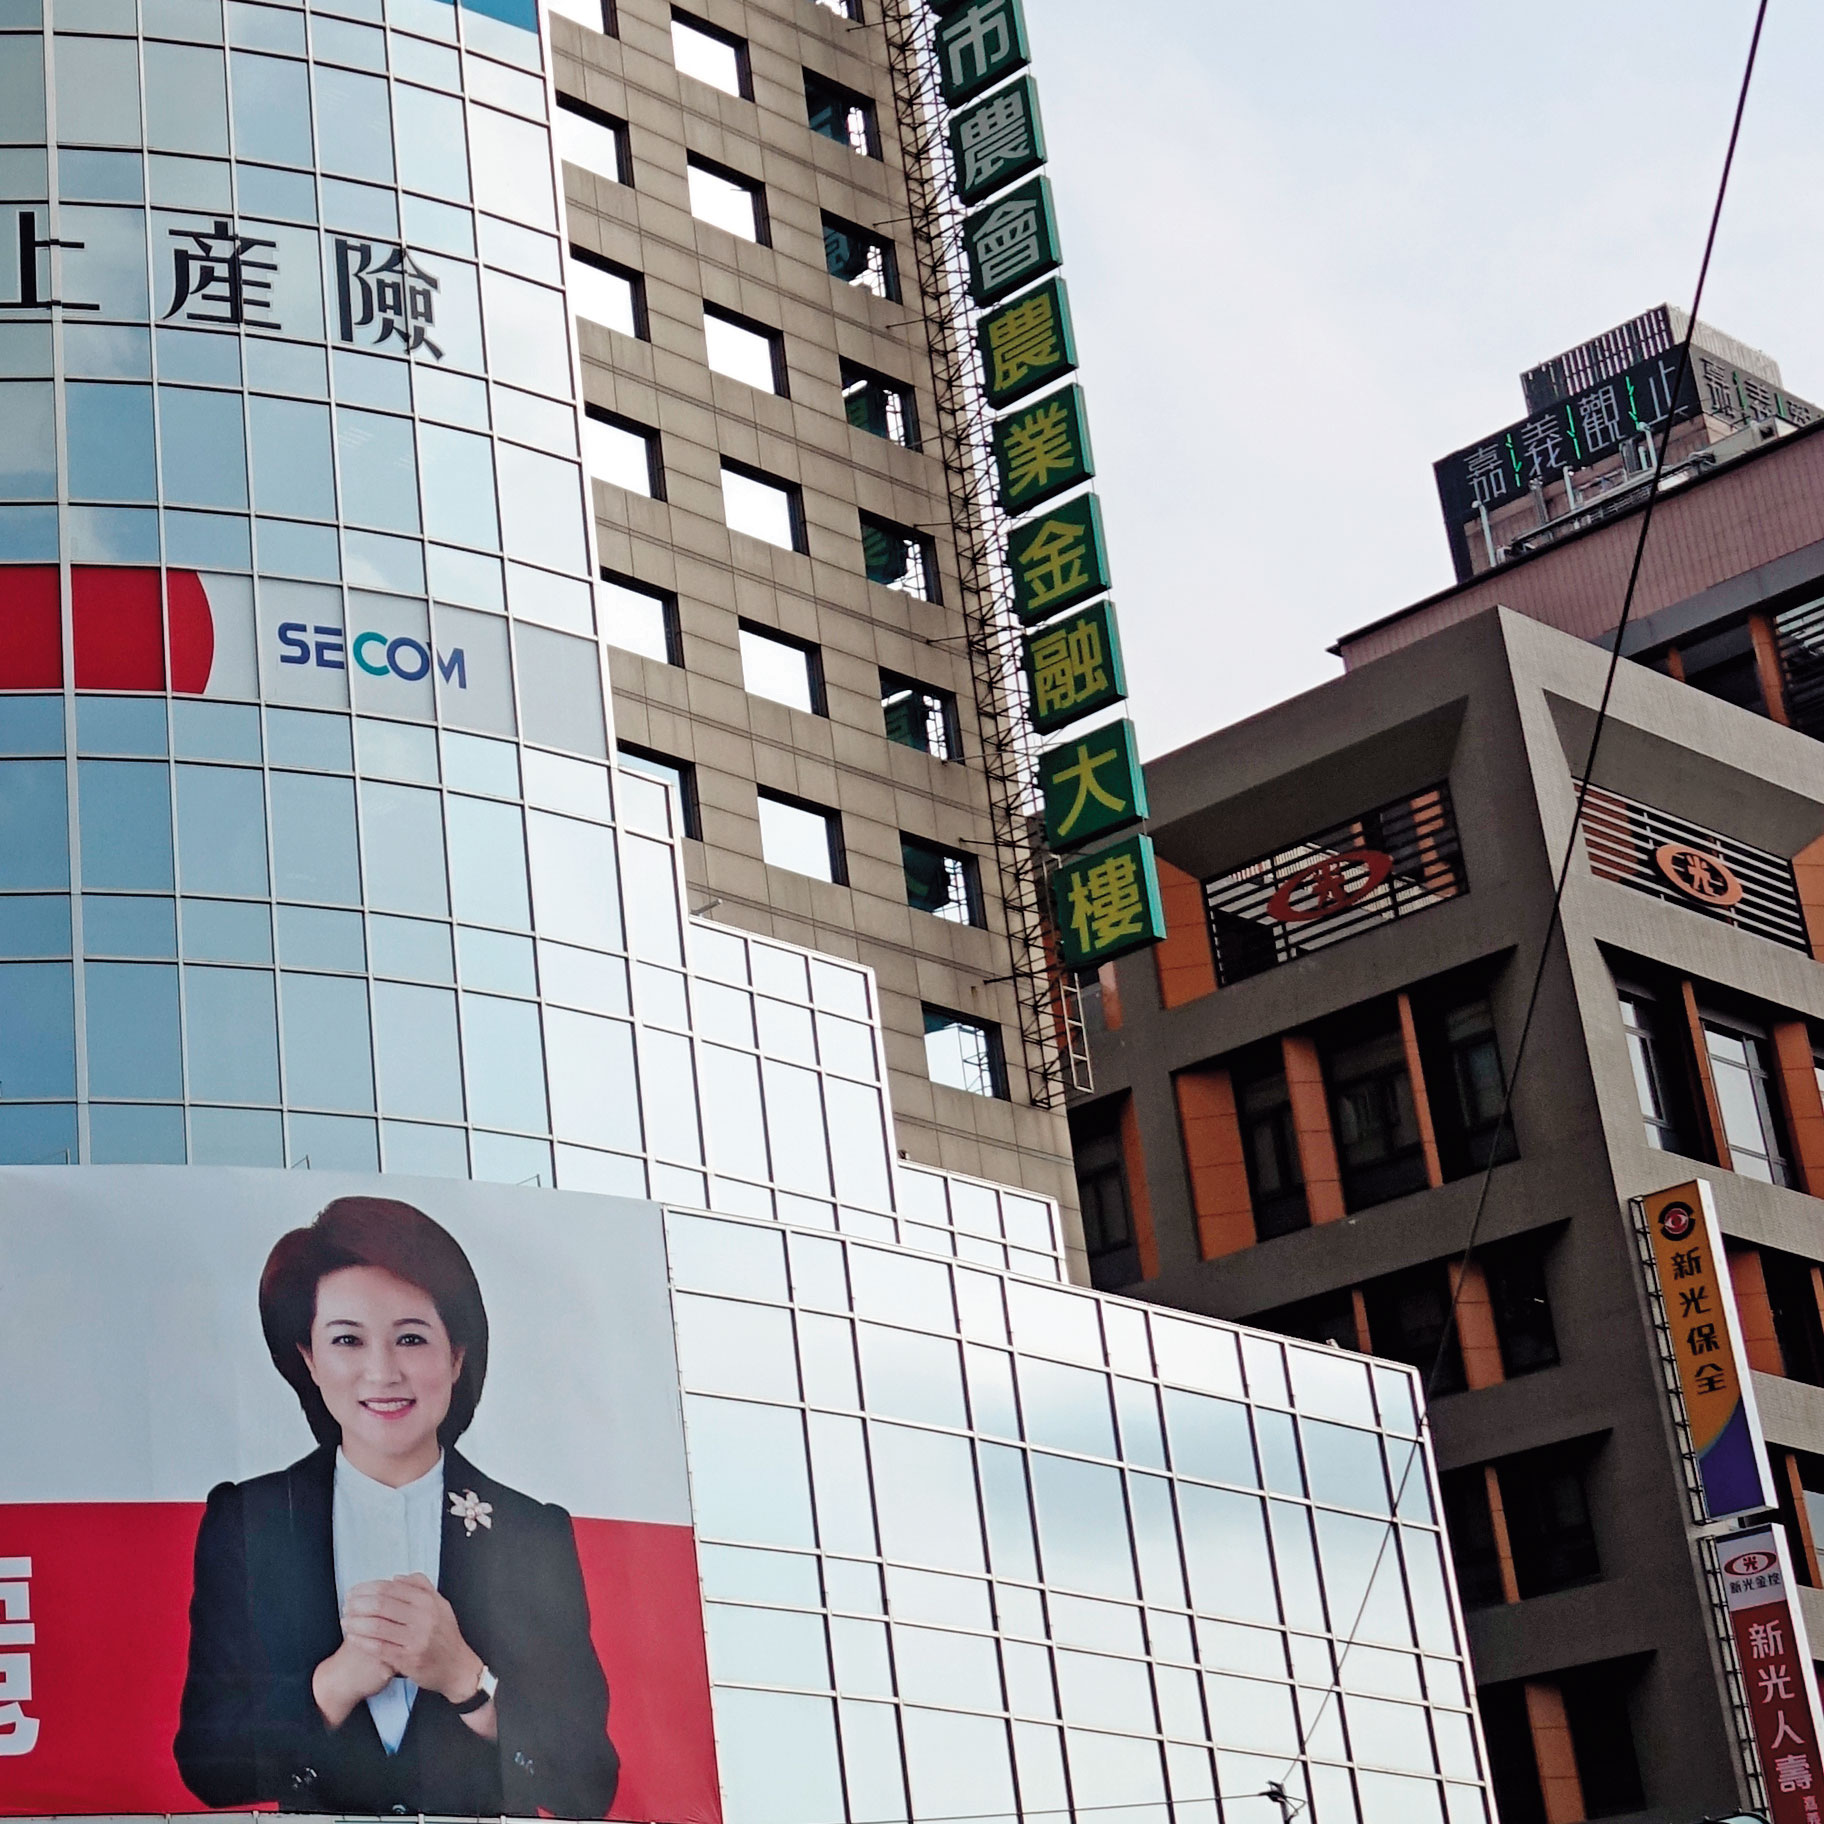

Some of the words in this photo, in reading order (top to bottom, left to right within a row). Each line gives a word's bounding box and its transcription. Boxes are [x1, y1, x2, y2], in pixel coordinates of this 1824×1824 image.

[1462, 359, 1689, 504] 嘉義觀止
[277, 620, 467, 691] SECOM
[1670, 1247, 1727, 1396] 新光保全
[1729, 1573, 1782, 1595] 新光金控
[1748, 1619, 1814, 1793] 新光人壽
